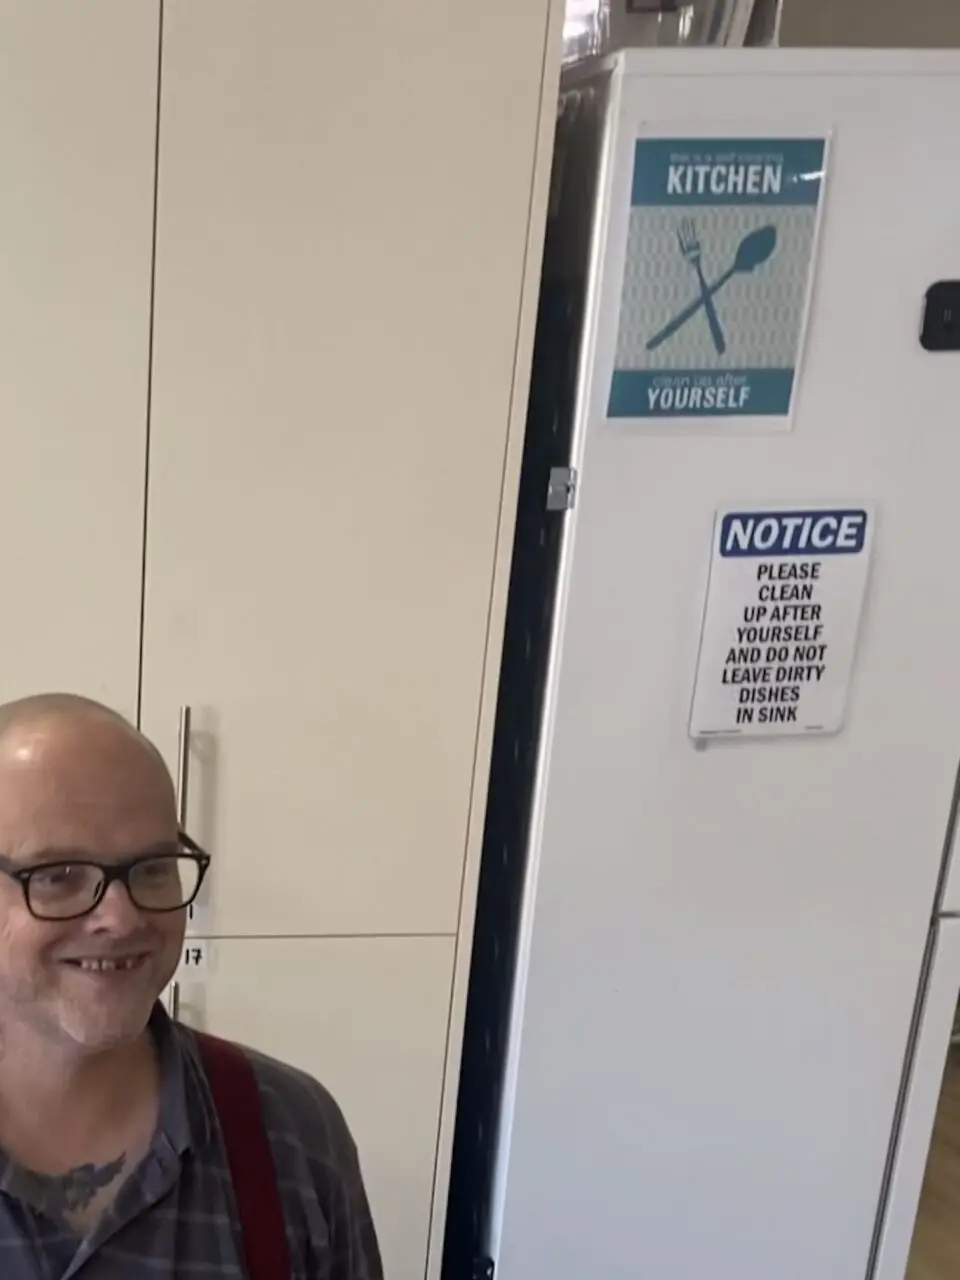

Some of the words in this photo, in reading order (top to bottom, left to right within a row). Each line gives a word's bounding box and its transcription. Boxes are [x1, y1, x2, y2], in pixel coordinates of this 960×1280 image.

[667, 165, 782, 194] KITCHEN
[648, 386, 751, 410] YOURSELF
[726, 515, 862, 551] NOTICE
[757, 562, 821, 581] PLEASE
[758, 584, 812, 601] CLEAN
[743, 606, 767, 622] UP
[770, 604, 821, 621] AFTER
[737, 625, 823, 644] YOURSELF
[725, 648, 761, 664] AND
[765, 647, 788, 662] DO
[793, 645, 827, 661] NOT
[722, 667, 772, 684] LEAVE
[775, 665, 825, 682] DIRTY
[739, 686, 800, 703] DISHES
[736, 708, 753, 724] IN
[758, 707, 798, 722] SINK
[185, 948, 202, 966] 17
